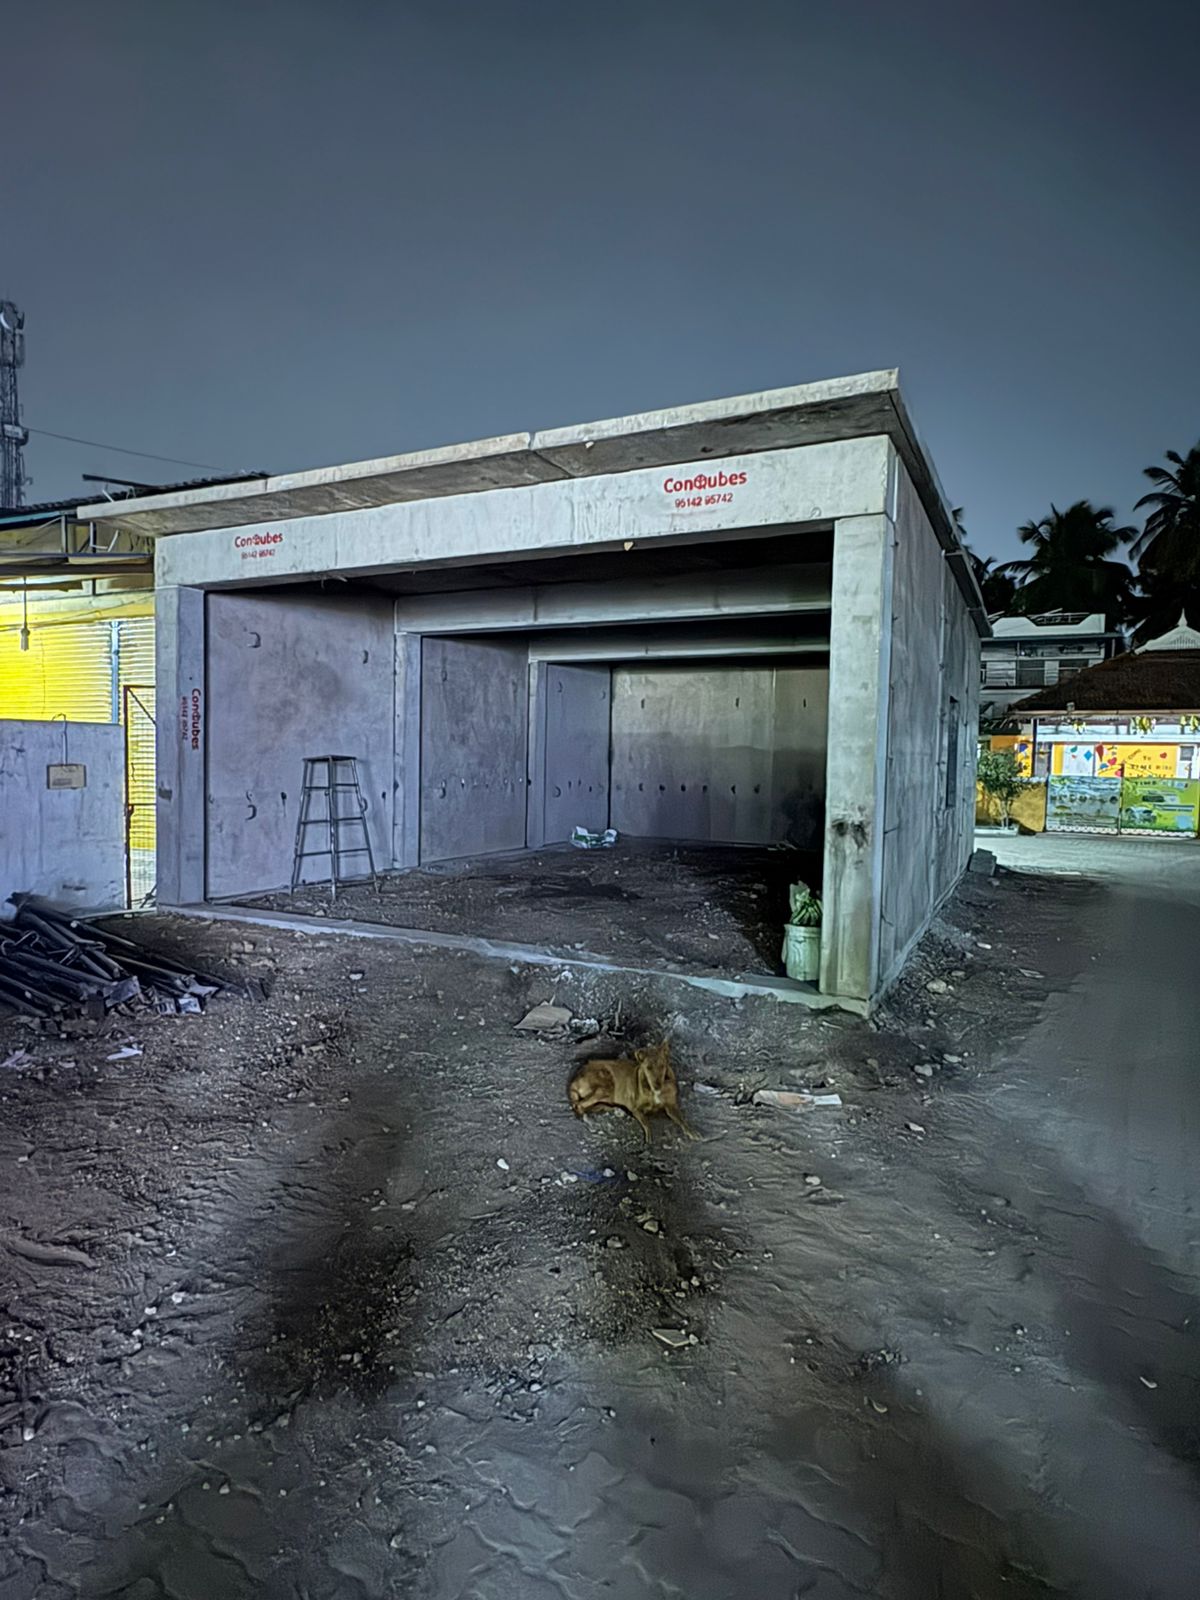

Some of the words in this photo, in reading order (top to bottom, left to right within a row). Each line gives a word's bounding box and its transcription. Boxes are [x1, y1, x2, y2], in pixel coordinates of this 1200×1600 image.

[663, 471, 748, 493] ConQubes
[234, 531, 284, 548] ConQubes
[191, 688, 202, 750] ConQubes
